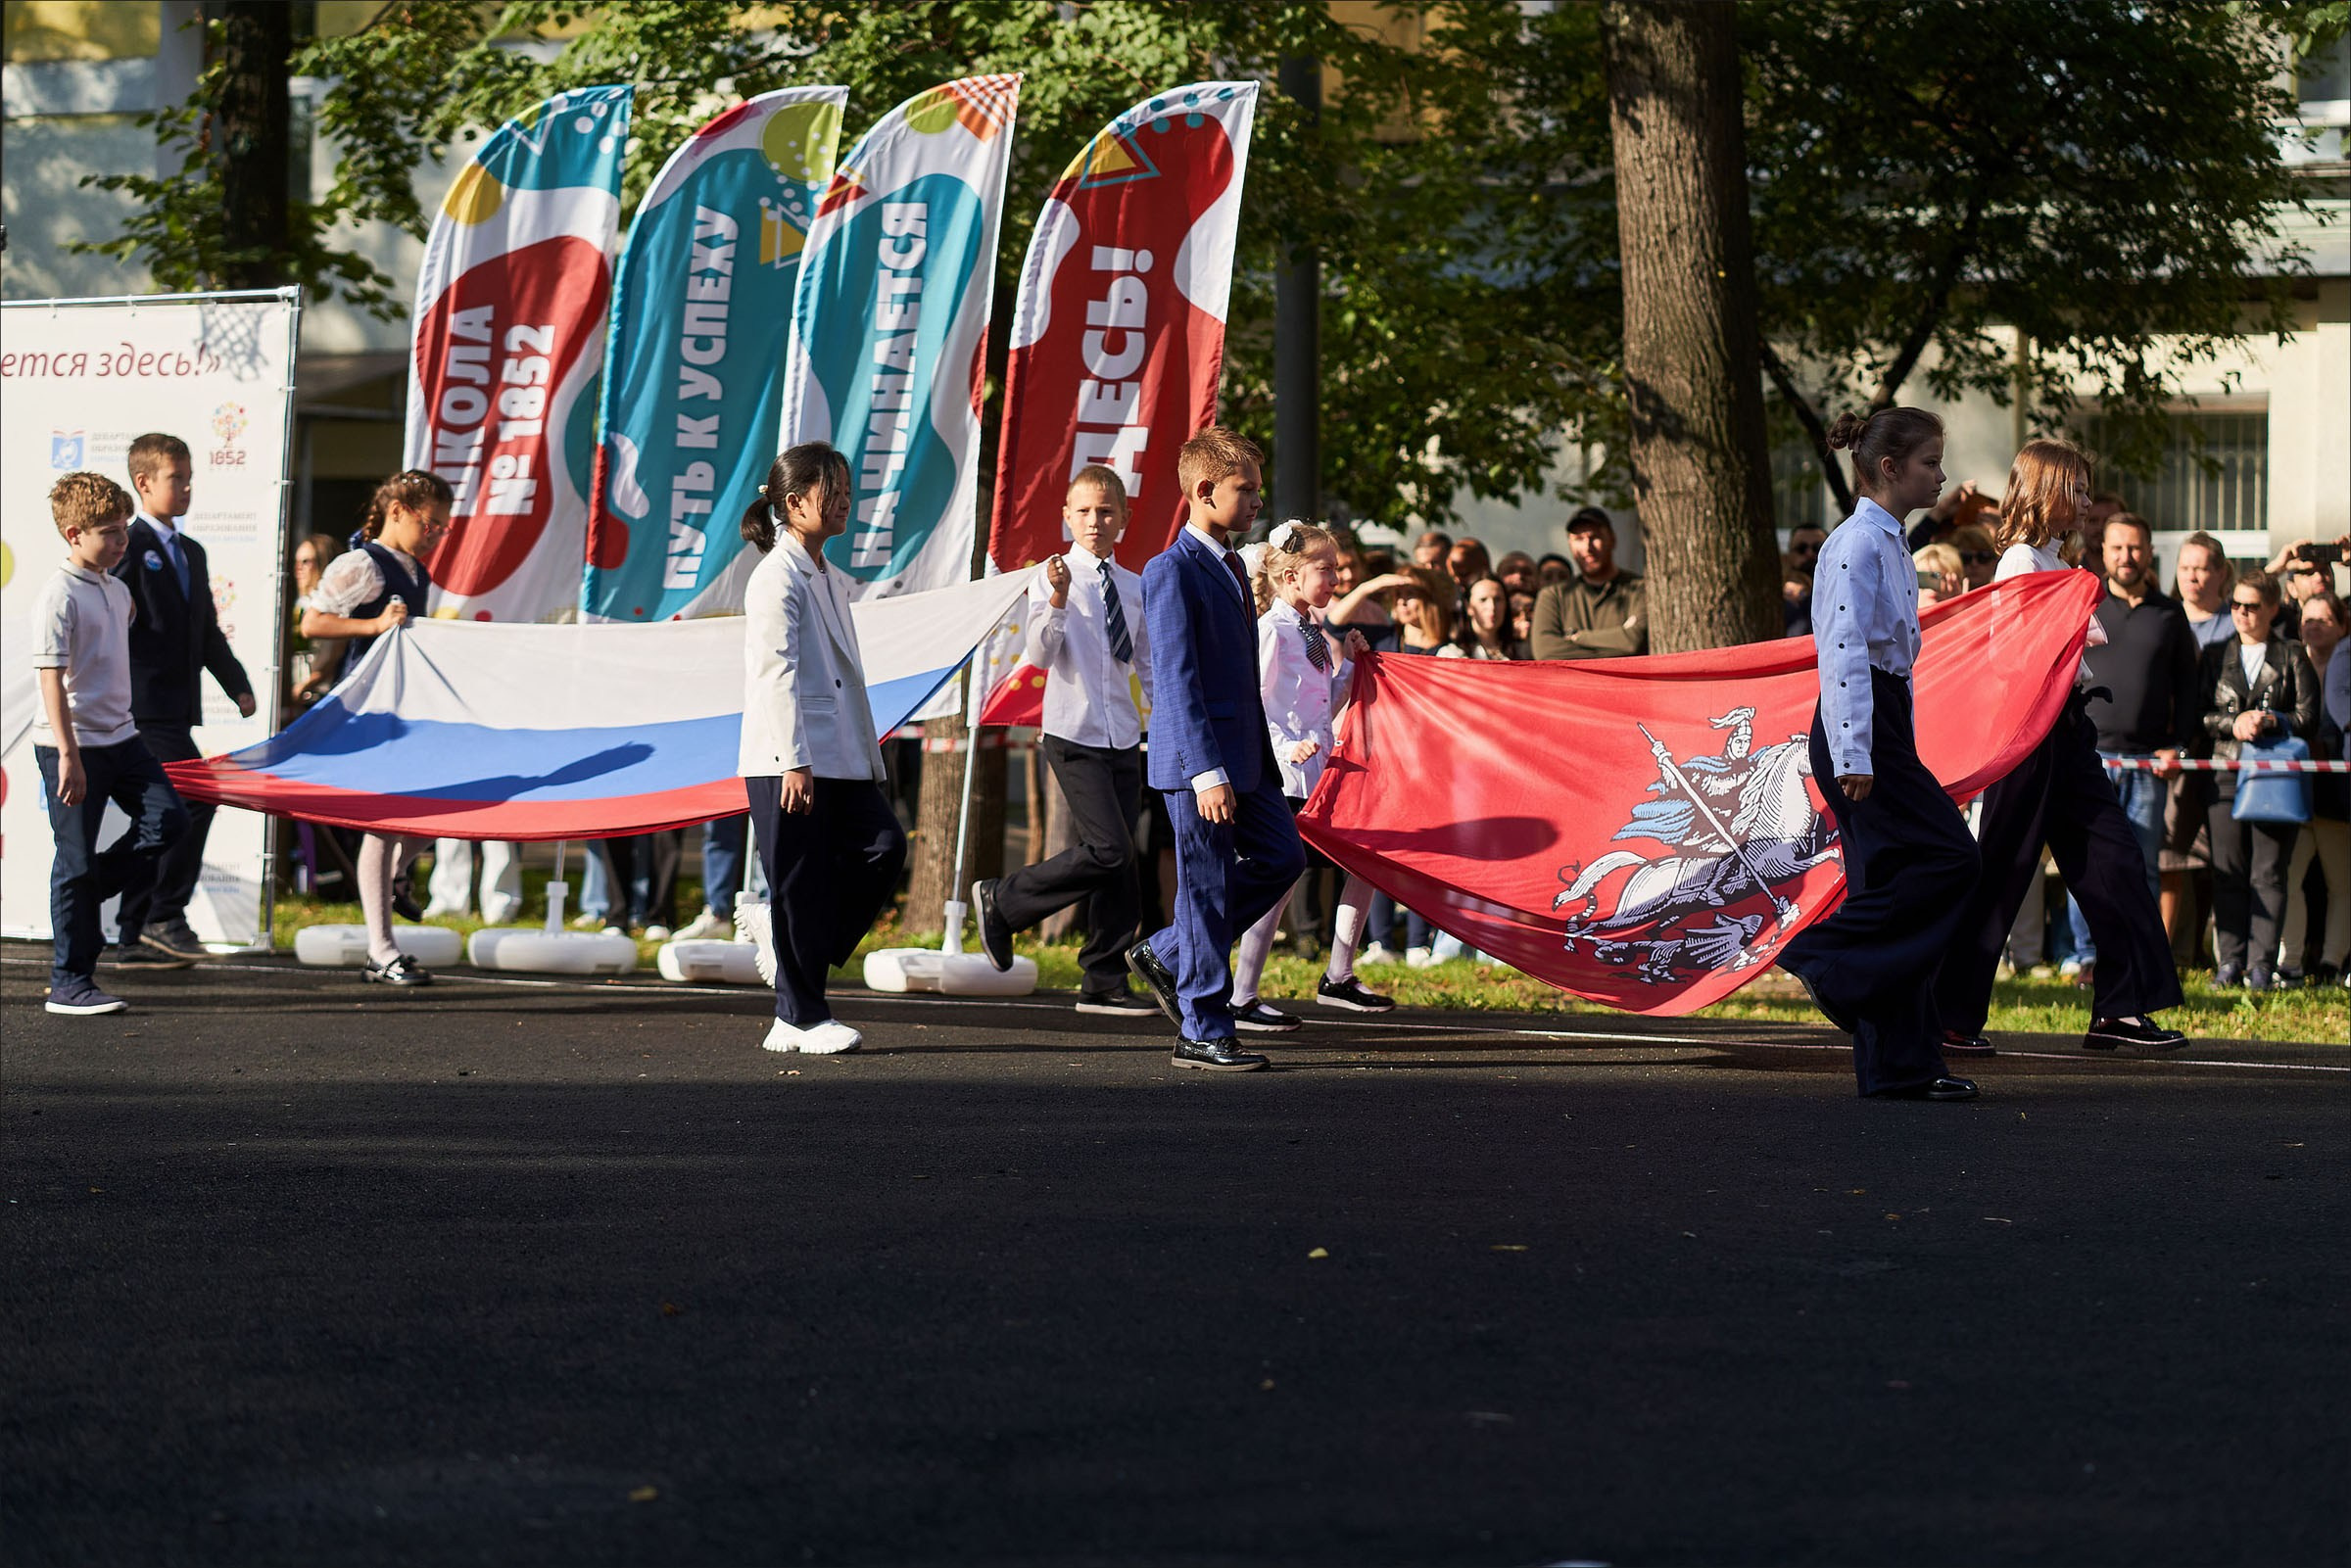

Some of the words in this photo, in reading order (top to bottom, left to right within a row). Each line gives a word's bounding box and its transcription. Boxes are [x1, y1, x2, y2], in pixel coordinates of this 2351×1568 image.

[1, 352, 87, 377] ется
[96, 341, 220, 377] здесь!»
[679, 205, 739, 401] УСПЕХУ
[498, 324, 555, 442] 1852
[676, 413, 720, 449] К
[850, 202, 928, 568] НАЧИНАЕТСЯ
[1061, 245, 1153, 543] ДЕСЬ!
[209, 450, 247, 465] 1852
[486, 453, 538, 516] №
[663, 460, 715, 590] ПУТЬ
